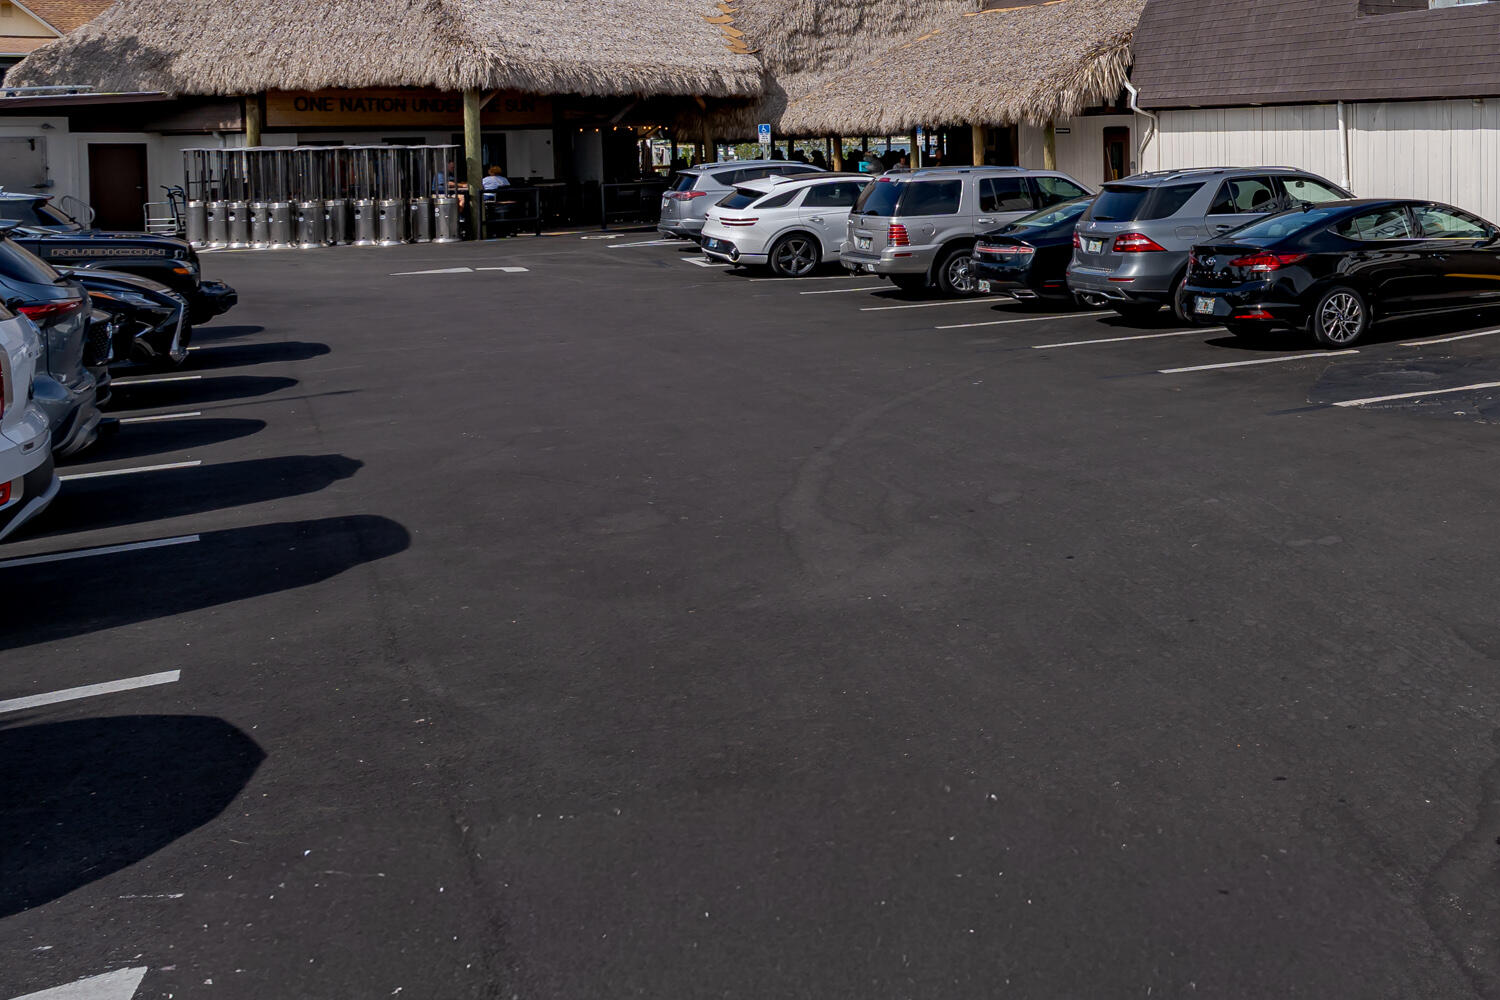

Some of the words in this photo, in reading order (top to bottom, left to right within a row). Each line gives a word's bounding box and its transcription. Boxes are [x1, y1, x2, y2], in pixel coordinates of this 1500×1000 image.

[294, 96, 334, 112] ONE
[340, 96, 407, 112] NATION
[51, 248, 166, 256] RUBICON
